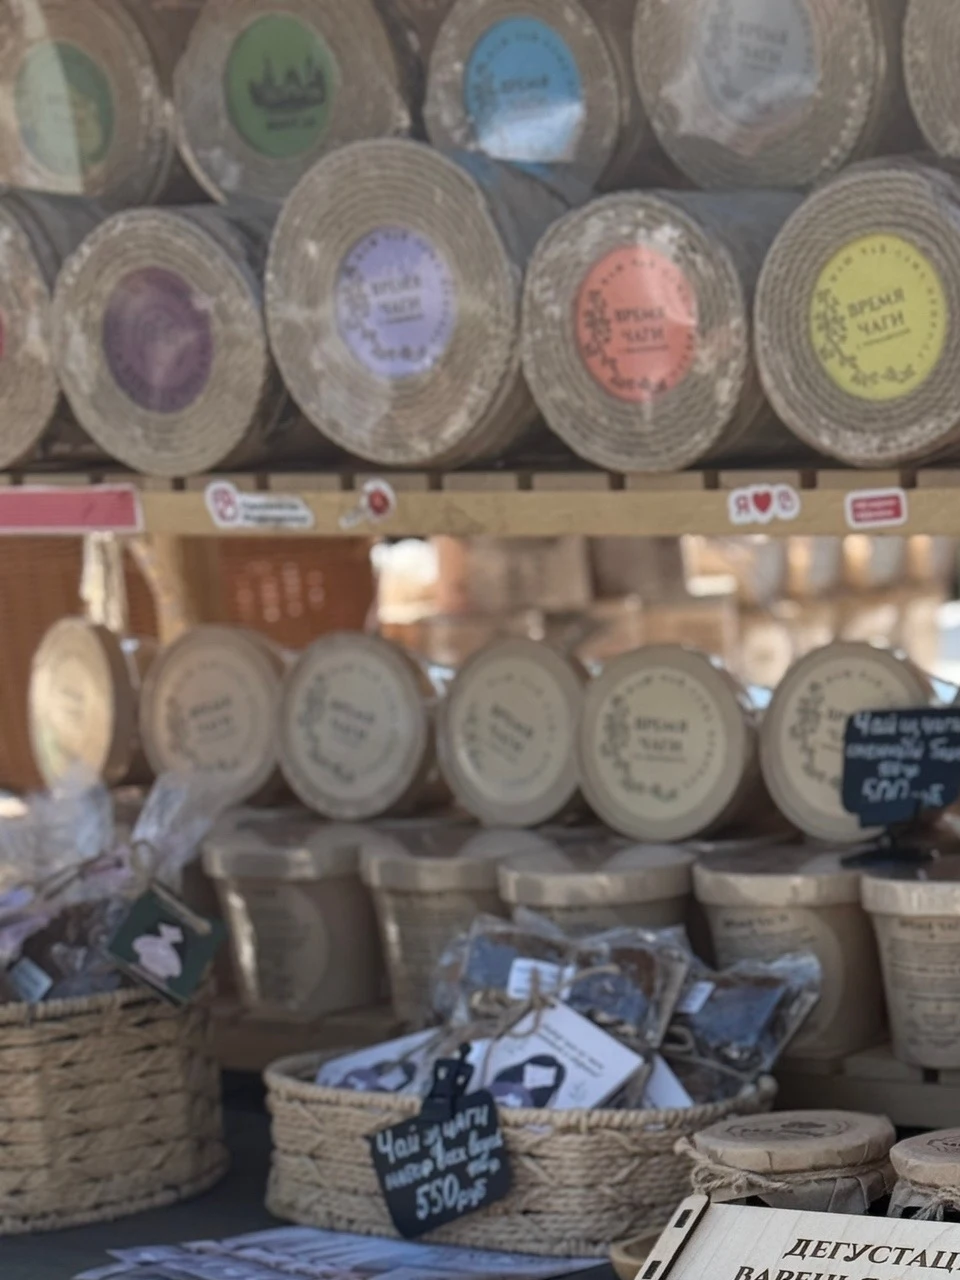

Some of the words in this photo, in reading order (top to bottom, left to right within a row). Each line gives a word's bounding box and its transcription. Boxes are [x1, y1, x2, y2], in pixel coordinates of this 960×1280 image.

[847, 288, 905, 318] ВРЕМЯ
[857, 309, 905, 335] ЧАГИ
[376, 1124, 421, 1164] Чай
